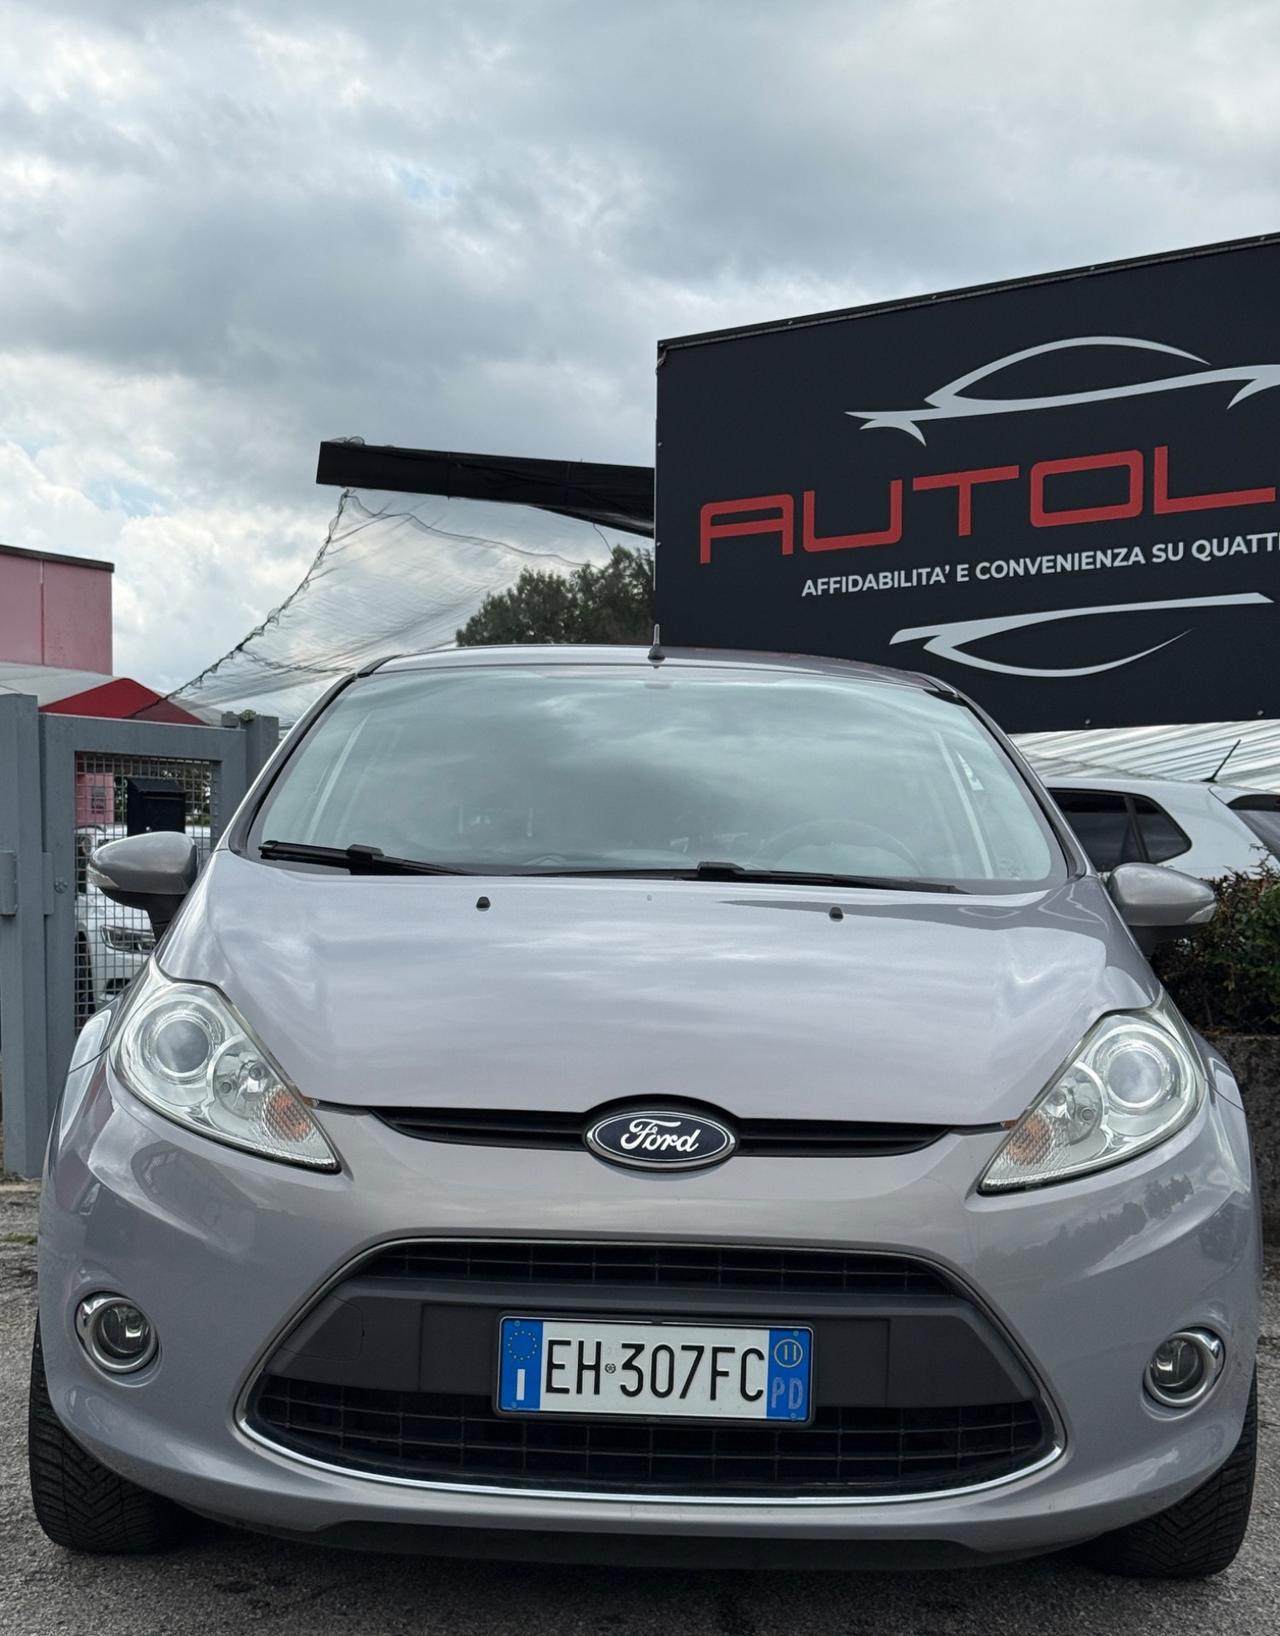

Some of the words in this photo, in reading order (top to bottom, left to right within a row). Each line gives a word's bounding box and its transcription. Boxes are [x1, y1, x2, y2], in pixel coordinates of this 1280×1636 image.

[700, 445, 1276, 564] AUTOL
[957, 563, 970, 582] E
[975, 546, 1146, 580] CONVENIENZA
[1151, 542, 1184, 563] SU
[1191, 532, 1280, 562] QUATT
[620, 1118, 702, 1153] Ford
[771, 1376, 804, 1410] PD
